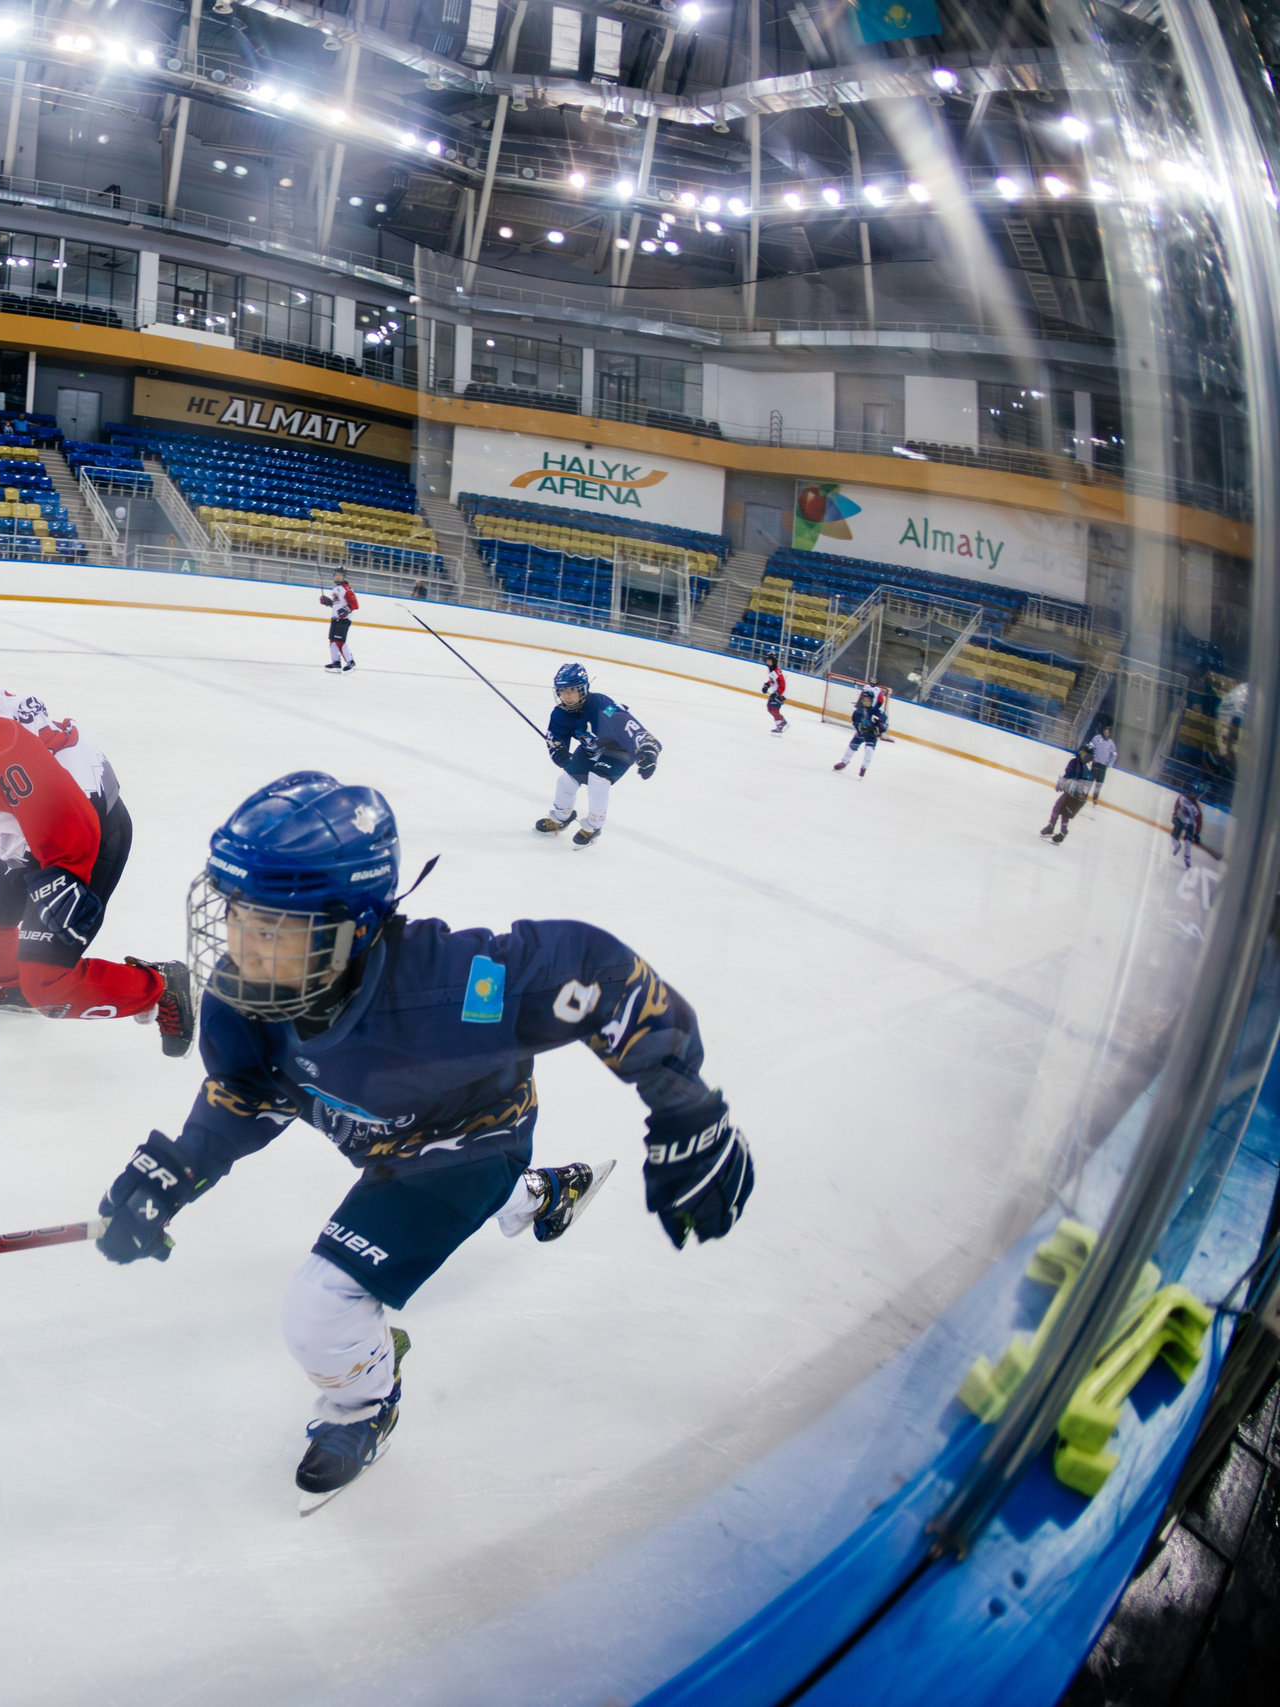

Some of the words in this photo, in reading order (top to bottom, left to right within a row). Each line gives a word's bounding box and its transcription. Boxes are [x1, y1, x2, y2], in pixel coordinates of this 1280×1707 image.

[186, 396, 220, 416] HC
[217, 395, 371, 448] ALMATY
[542, 451, 642, 482] HALYK
[537, 475, 642, 508] ARENA
[898, 517, 1005, 570] Almaty
[180, 559, 191, 573] A
[208, 854, 249, 880] BAUER
[349, 863, 392, 883] BAUER
[30, 874, 67, 903] UER
[18, 929, 55, 944] AUER
[648, 1110, 730, 1165] AUER
[321, 1219, 389, 1266] AUER
